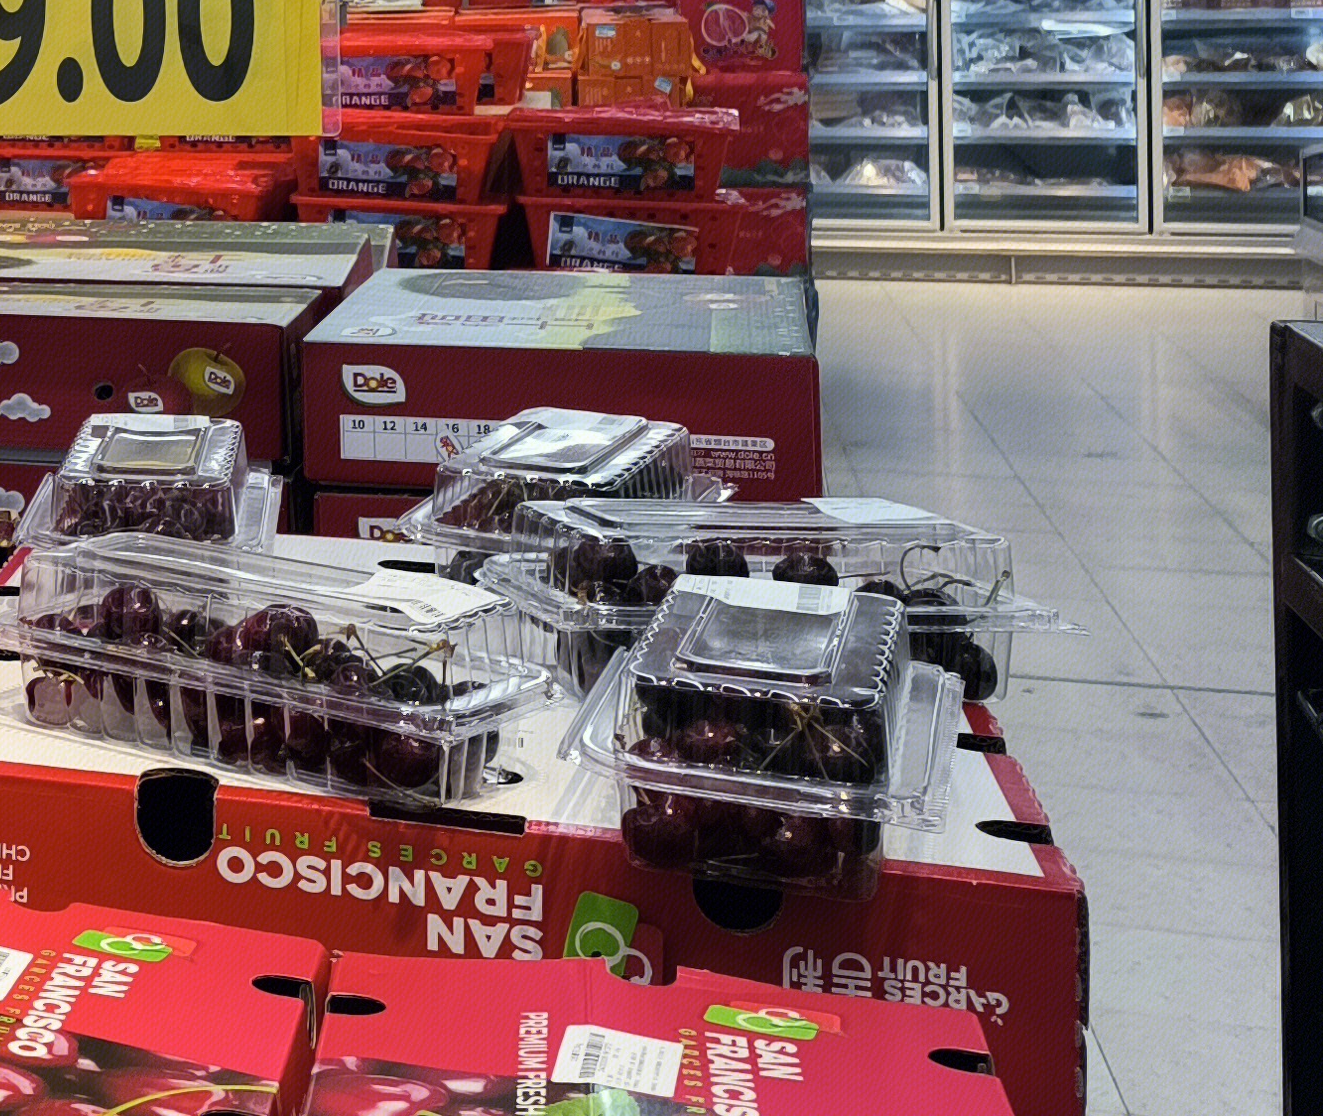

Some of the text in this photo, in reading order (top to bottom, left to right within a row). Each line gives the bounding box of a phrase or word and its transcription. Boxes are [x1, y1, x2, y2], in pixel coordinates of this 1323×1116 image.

[5, 192, 53, 203] ORANGE
[328, 179, 387, 194] ORANGE
[558, 174, 620, 187] ORANGE
[351, 370, 398, 392] Dole
[351, 419, 365, 431] 10
[382, 420, 397, 432] 12
[412, 421, 428, 433] 14
[476, 422, 491, 435] 18
[216, 822, 543, 878] GARCES FRUIT
[215, 845, 544, 919] FRANCISCO
[427, 914, 544, 961] SAN
[14, 949, 56, 1002] GARCES
[90, 959, 140, 999] SAN
[877, 956, 969, 987] FRUIT
[7, 952, 98, 1059] FRANCISCO
[515, 1011, 549, 1116] PREMIUM FRESH
[677, 1027, 701, 1096] GARCES
[755, 1039, 805, 1082] SAN
